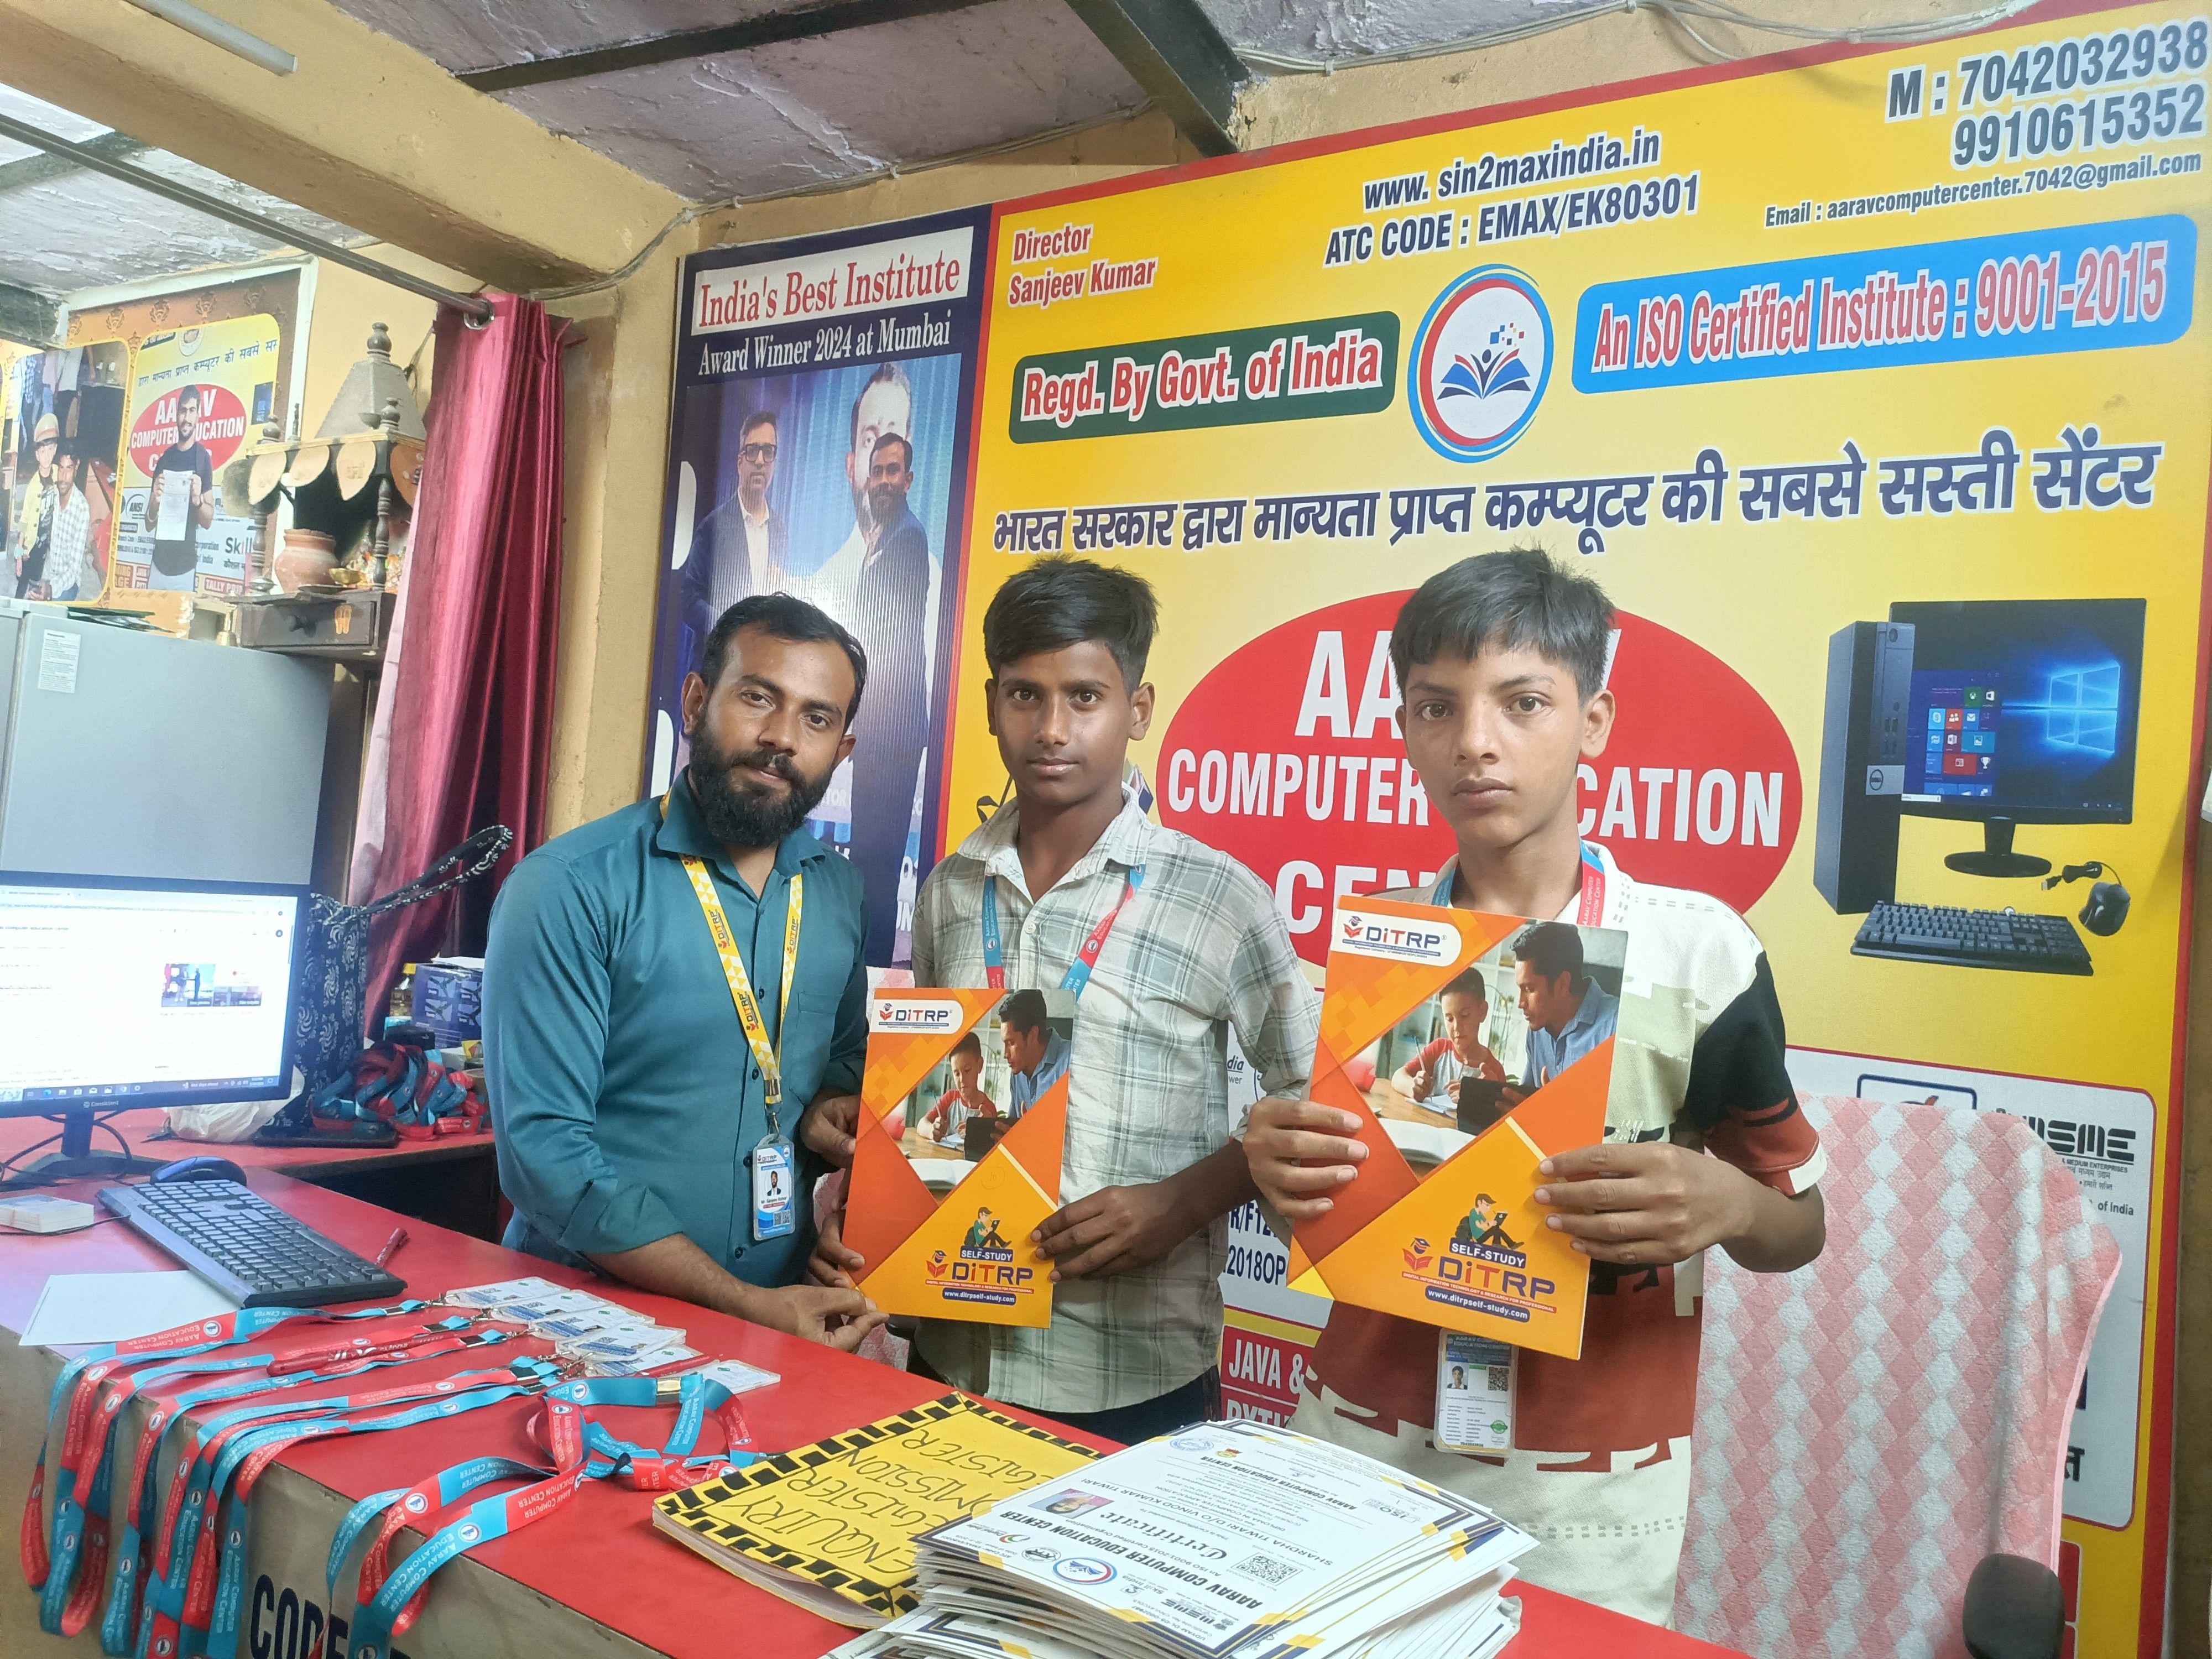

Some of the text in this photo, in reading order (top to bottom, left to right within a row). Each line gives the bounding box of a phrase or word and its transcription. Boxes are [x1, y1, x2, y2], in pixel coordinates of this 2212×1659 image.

[1889, 21, 2206, 120] M 7042032938
[1954, 85, 2203, 165] 9910615352
[1439, 128, 1660, 198] sin2maxindia.in
[1766, 153, 2200, 227] Email aaravcomputercenter.7042@gmail.com
[1326, 175, 1699, 264] ATC CODE EMAX/EK80301
[1014, 225, 1091, 260] Director
[700, 249, 959, 327] India's Best Institute
[1010, 260, 1156, 307] Sanjeev Kumar
[1594, 242, 2167, 368] An ISO Certified Institute 9001-2015
[698, 310, 950, 375] Award Winner 2024 at Mumbai
[1024, 333, 1378, 425] Regd. By Govt. of India
[155, 389, 217, 425] AAV
[131, 416, 244, 448] COMPUTER UCATION
[995, 426, 2162, 554] भारत सरकार द्वारा मान्यता प्राप्त कम्प्यूटर की सबसे सस्ती सेंटर
[1168, 748, 1783, 848] COMPUTER CATION
[1228, 1055, 1244, 1071] dia
[2067, 1159, 2128, 1173] MEDIUM ENTERPRISES
[2098, 1202, 2133, 1215] of India
[961, 1250, 1012, 1261] SELF-STUDY
[1227, 1245, 1286, 1285] 2018OP
[1451, 1243, 1525, 1267] SELF-STUDY
[945, 1291, 1015, 1303] www.ditrpself-study.com
[1403, 1272, 1420, 1281] DIGITAL
[1420, 1276, 1449, 1287] INFORMATION
[1451, 1283, 1479, 1295] TECHNOLOGY
[1484, 1292, 1509, 1302] RESEARCH
[1520, 1300, 1554, 1312] PROFESSIONAL
[1428, 1289, 1528, 1319] www.ditrpself-study.com
[1229, 1339, 1304, 1394] JAVA &
[787, 1466, 948, 1535] EGISTER
[1082, 1478, 1120, 1493] TIWARI
[1121, 1489, 1162, 1504] KUMAR
[1200, 1456, 1357, 1511] AARAV COMPUTER EDUCATION CENTER
[999, 1511, 1052, 1532] CENTER
[1163, 1502, 1198, 1516] VINOD
[1052, 1524, 1126, 1556] EDUCATION
[1100, 1511, 1227, 1560] Certificate
[1227, 1524, 1270, 1541] TIWARI
[1125, 1550, 1208, 1586] COMPUTER
[1192, 1563, 1208, 1573] ISO
[1273, 1540, 1333, 1566] SHARDHA
[1206, 1583, 1263, 1609] AARAV
